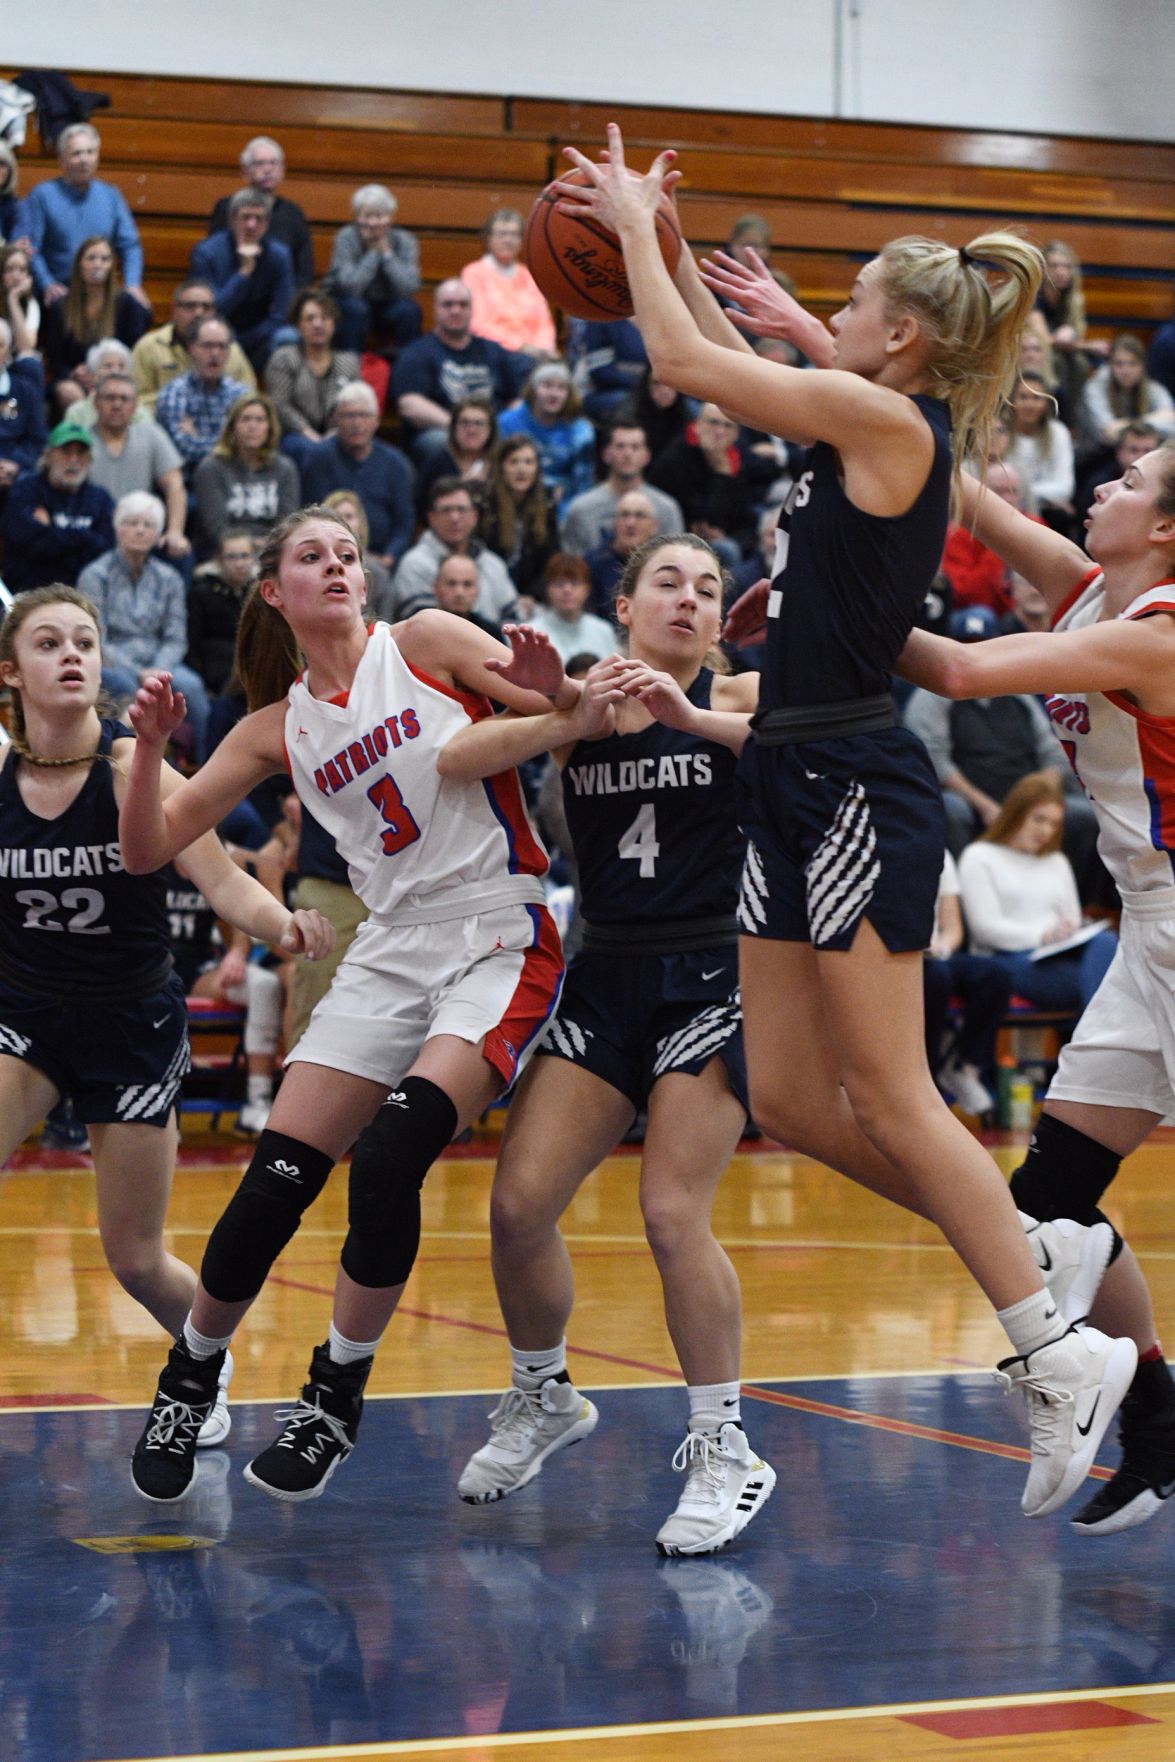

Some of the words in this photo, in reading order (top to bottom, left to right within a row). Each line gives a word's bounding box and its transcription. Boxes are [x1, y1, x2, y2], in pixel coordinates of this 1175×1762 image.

[314, 708, 421, 797] PATRIOTS
[568, 753, 713, 795] WILDCATS
[367, 772, 421, 856] 3
[618, 803, 660, 878] 4
[15, 887, 112, 934] 22
